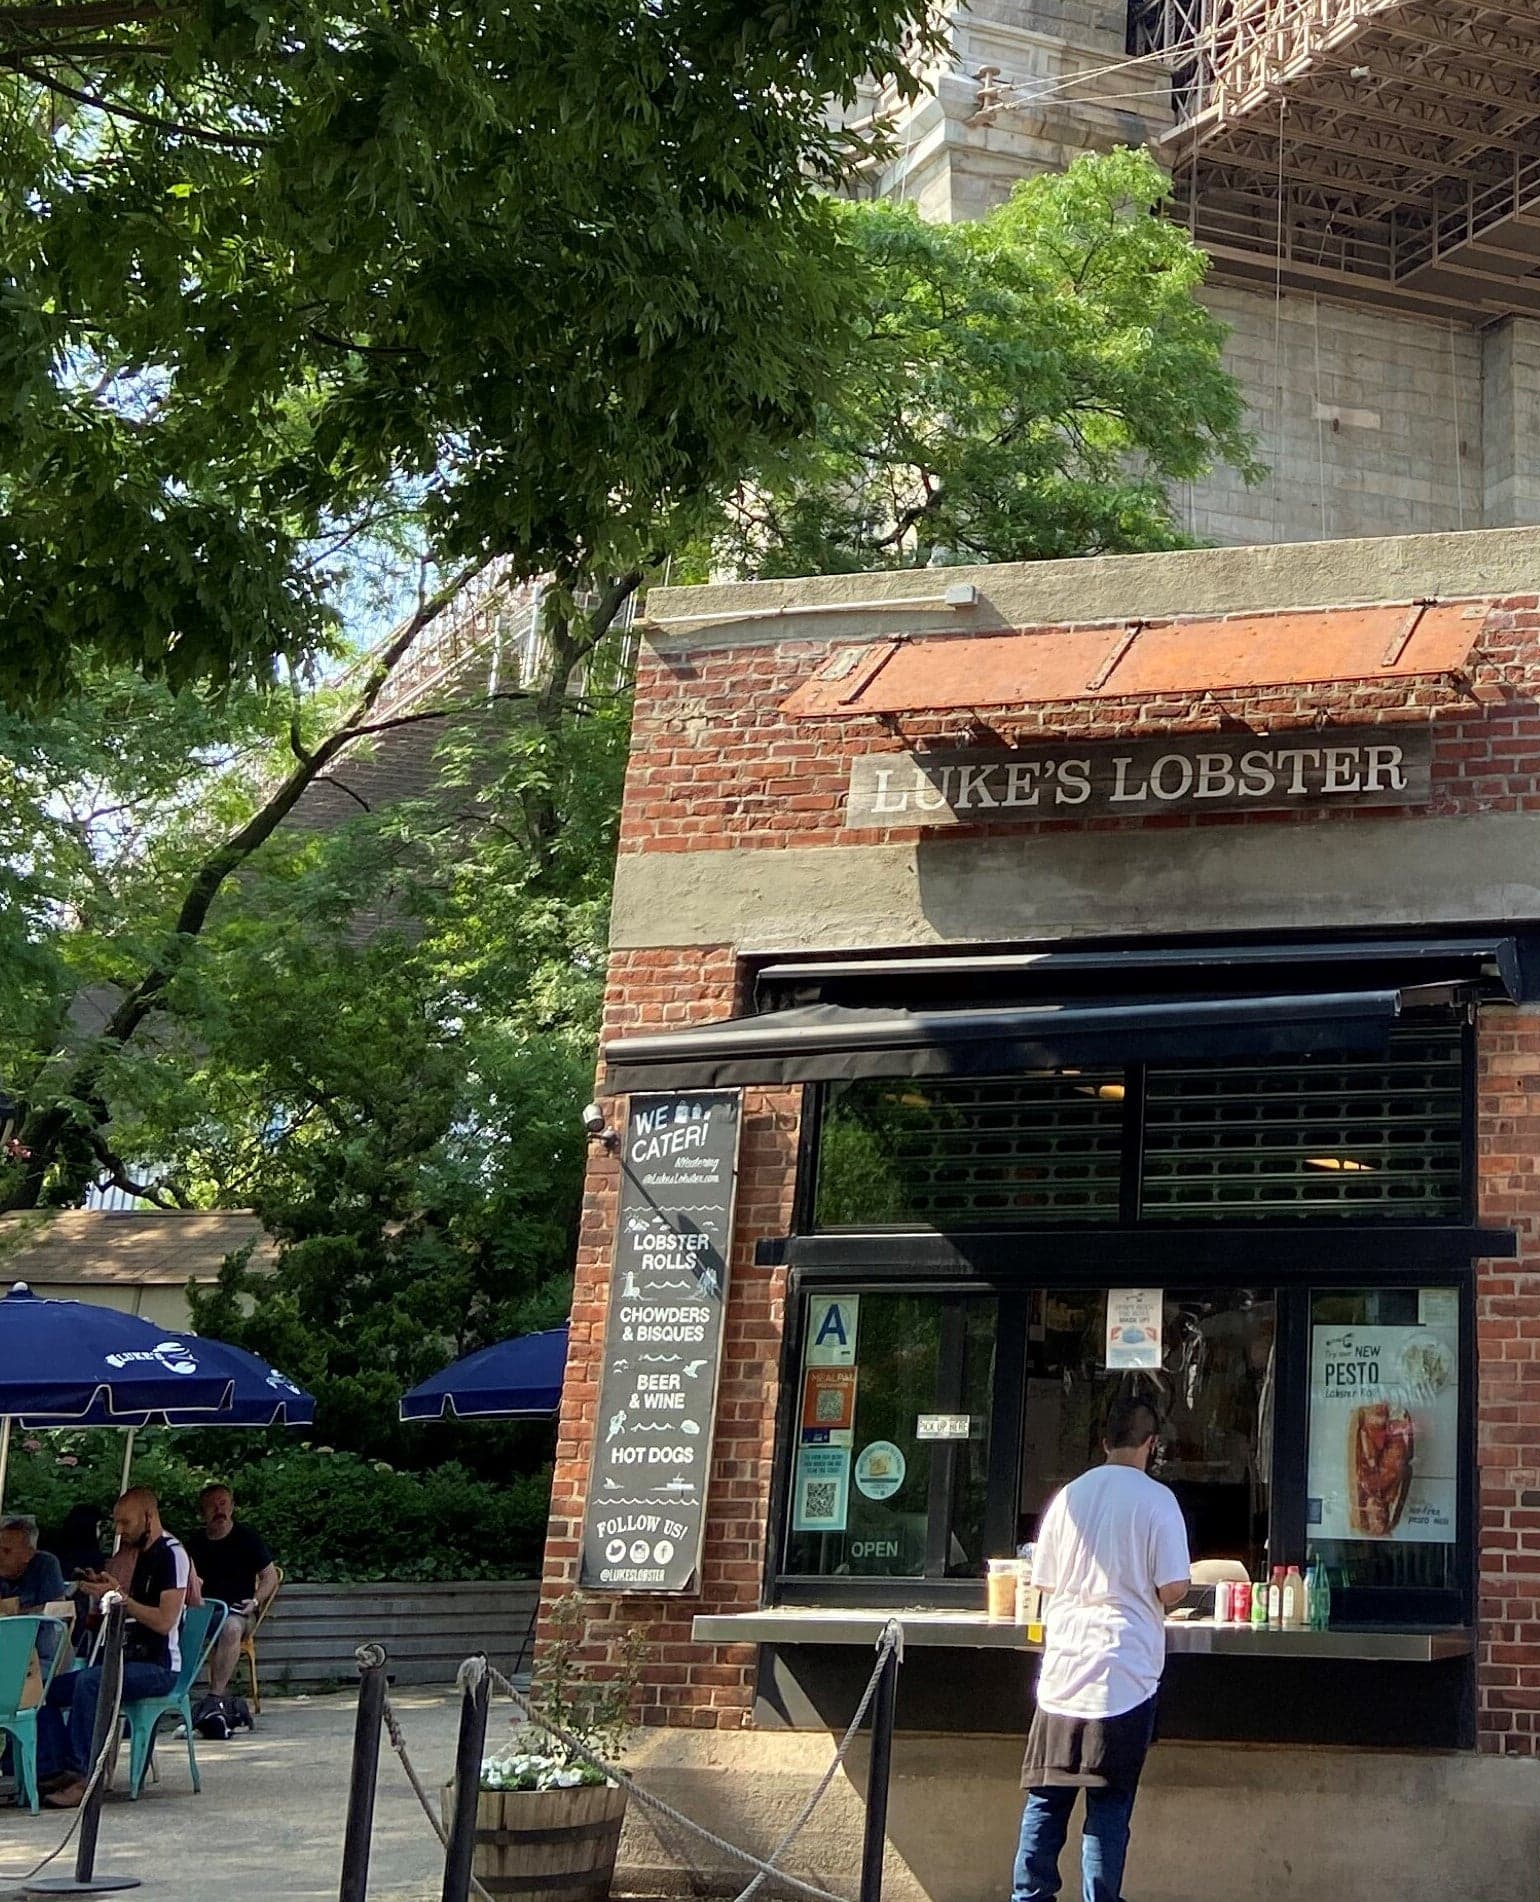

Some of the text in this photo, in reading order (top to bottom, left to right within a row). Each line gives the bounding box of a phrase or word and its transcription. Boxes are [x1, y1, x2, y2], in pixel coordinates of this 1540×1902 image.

[871, 745, 1408, 814] LUKE'S LOBSTER
[635, 1105, 669, 1136] WE
[631, 1122, 710, 1163] CATER!
[633, 1234, 709, 1251] LOBSTER
[642, 1253, 697, 1270] ROLLS
[620, 1307, 710, 1324] CHOWDERS
[815, 1304, 847, 1346] A
[622, 1326, 705, 1342] & BISQUES
[1355, 1345, 1381, 1357] NEW
[636, 1374, 681, 1391] BEER
[1325, 1361, 1379, 1387] PESTO
[629, 1393, 685, 1409] & WINE
[611, 1447, 694, 1464] HOT DOGS
[597, 1514, 688, 1540] FOLLOW US!
[851, 1540, 899, 1558] OPEN
[600, 1568, 666, 1583] @LUKESLOBSTER
